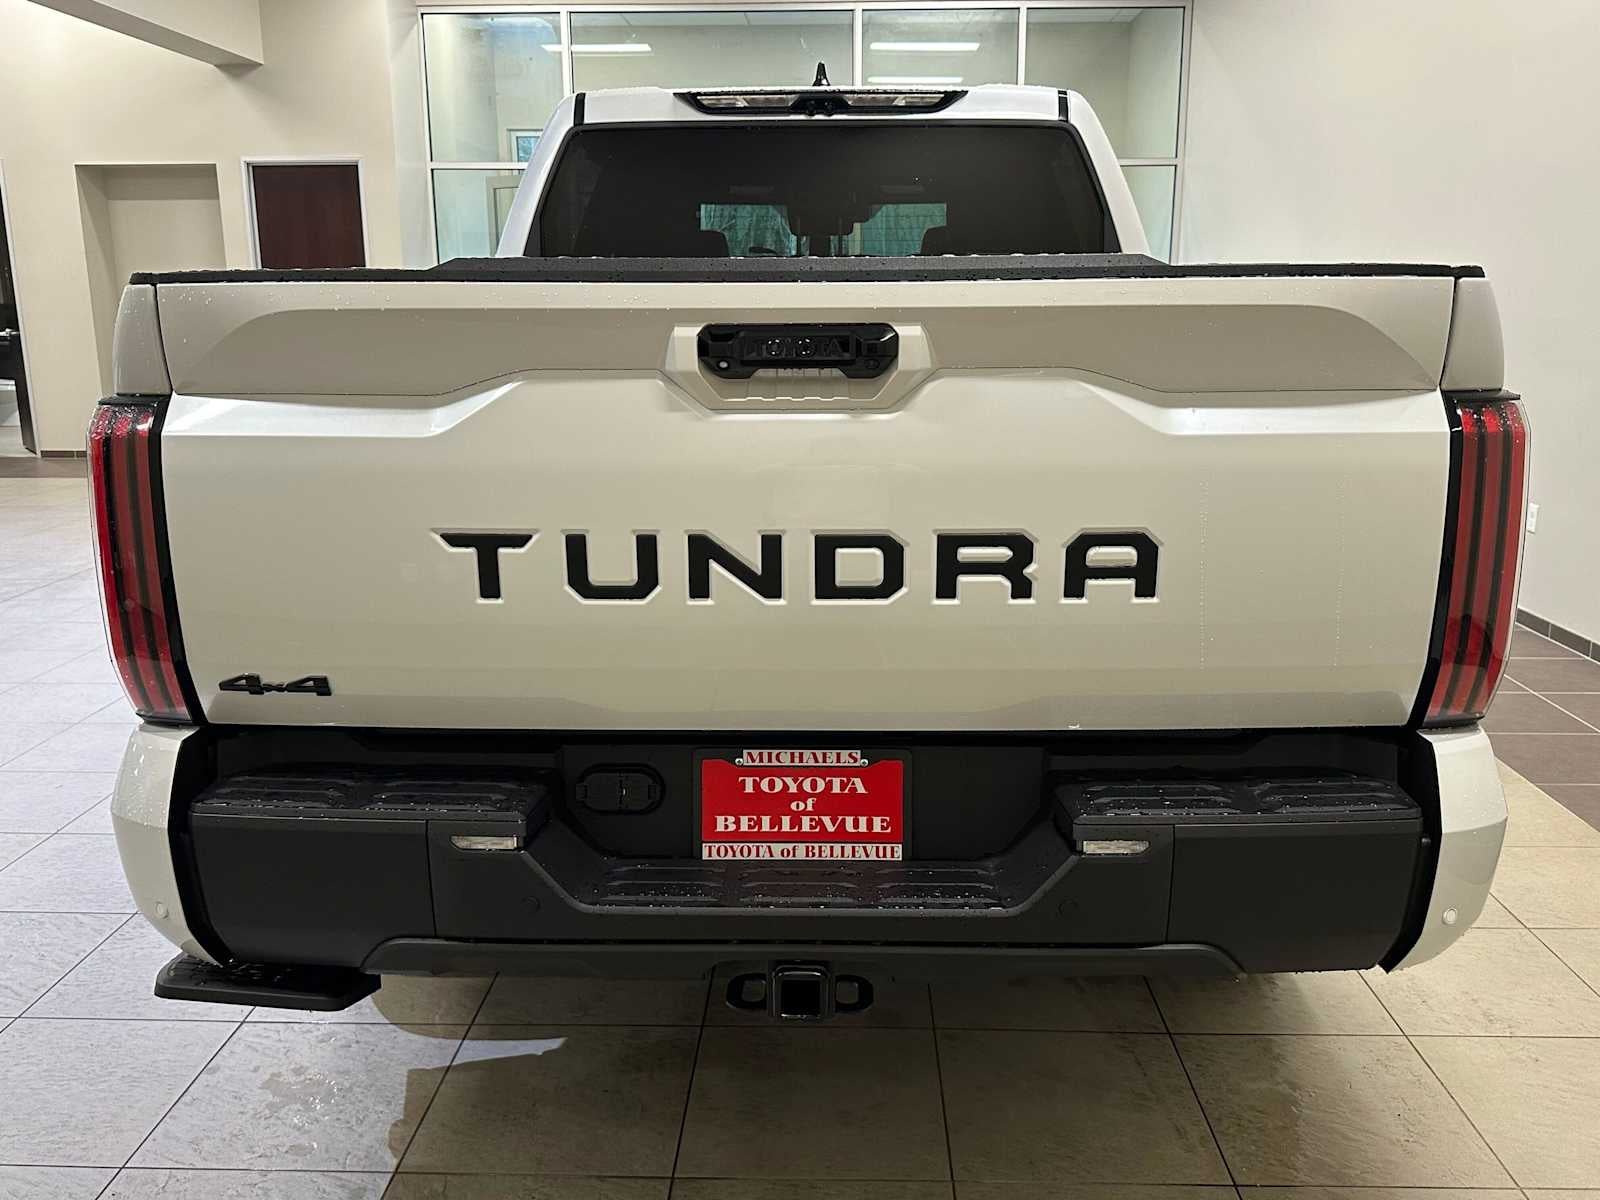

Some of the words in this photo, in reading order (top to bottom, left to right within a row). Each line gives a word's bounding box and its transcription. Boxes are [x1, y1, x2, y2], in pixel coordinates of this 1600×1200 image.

[435, 530, 1161, 604] TUNDRA
[745, 751, 860, 764] MICHAELS
[738, 776, 868, 794] TOYOTA
[790, 797, 817, 812] of
[714, 815, 892, 833] BELLEVUE
[704, 845, 775, 859] TOYOTA
[780, 846, 799, 859] of
[804, 845, 901, 859] BELLEVUE
